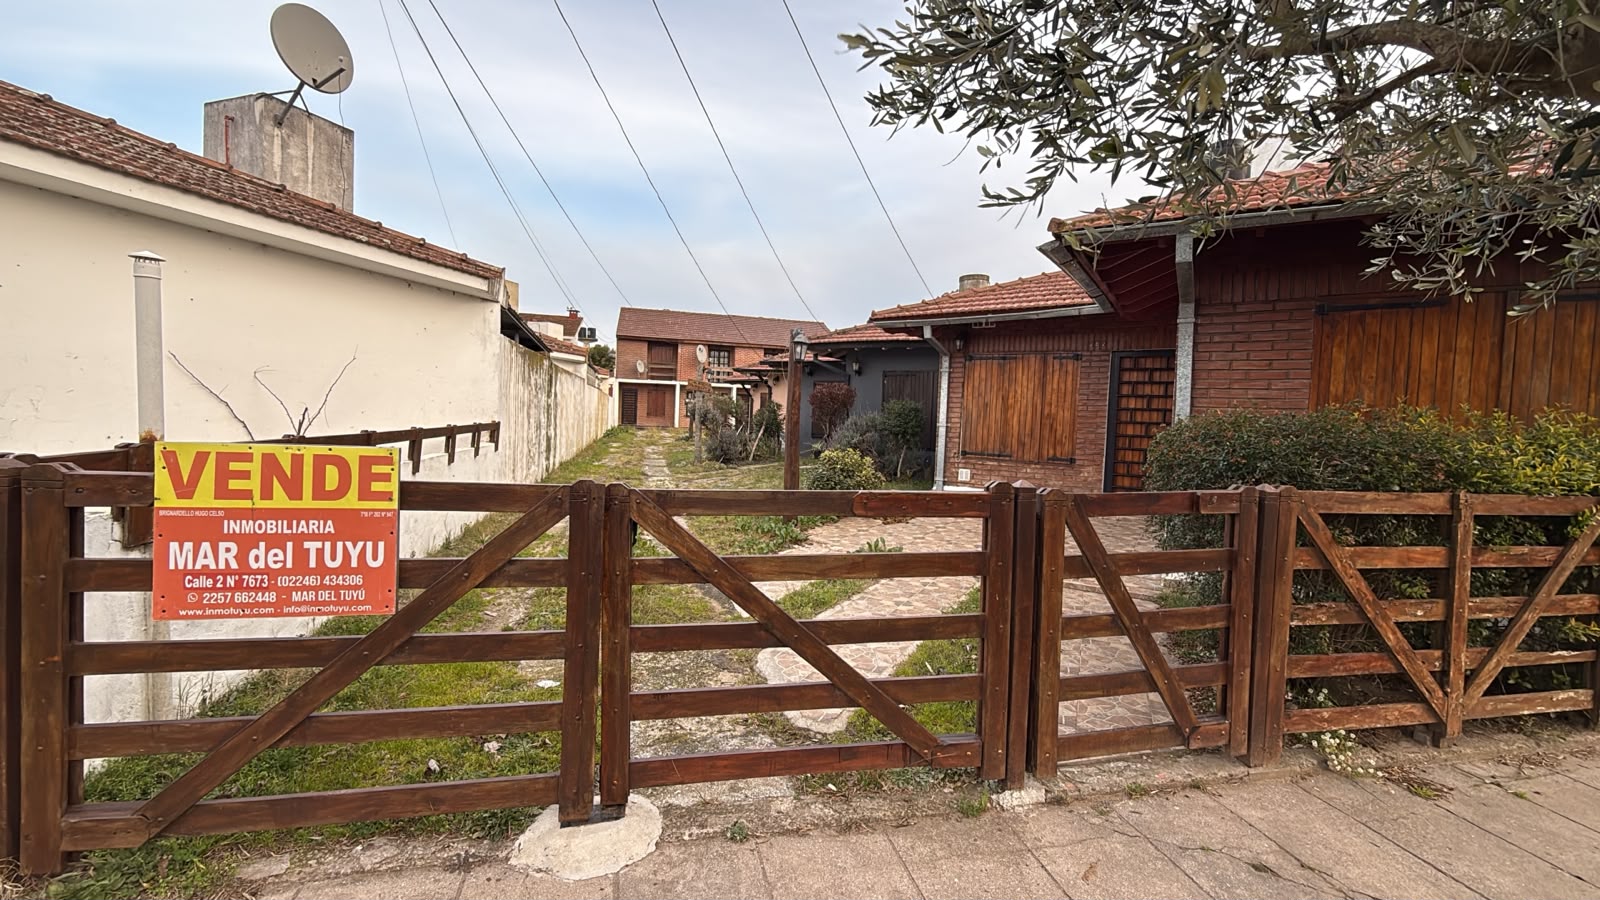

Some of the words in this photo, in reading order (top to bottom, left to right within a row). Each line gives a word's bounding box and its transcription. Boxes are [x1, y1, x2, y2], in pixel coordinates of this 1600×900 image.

[160, 450, 394, 502] VENDE
[223, 519, 335, 534] INMOBILIARIA
[168, 541, 239, 570] MAR
[248, 541, 293, 570] del
[303, 540, 385, 569] TUYU
[185, 575, 213, 588] Calle
[216, 575, 223, 588] 2
[242, 574, 269, 588] 7673
[277, 575, 321, 587] (02246)
[323, 574, 363, 587] 434306
[202, 592, 231, 604] 2257
[234, 591, 277, 603] 662448
[292, 591, 316, 602] MAR
[318, 590, 337, 601] DEL
[339, 587, 365, 601] TUYÚ
[179, 606, 275, 617] www.inmotuyu.com
[283, 604, 372, 614] info@inmotuyu.com
